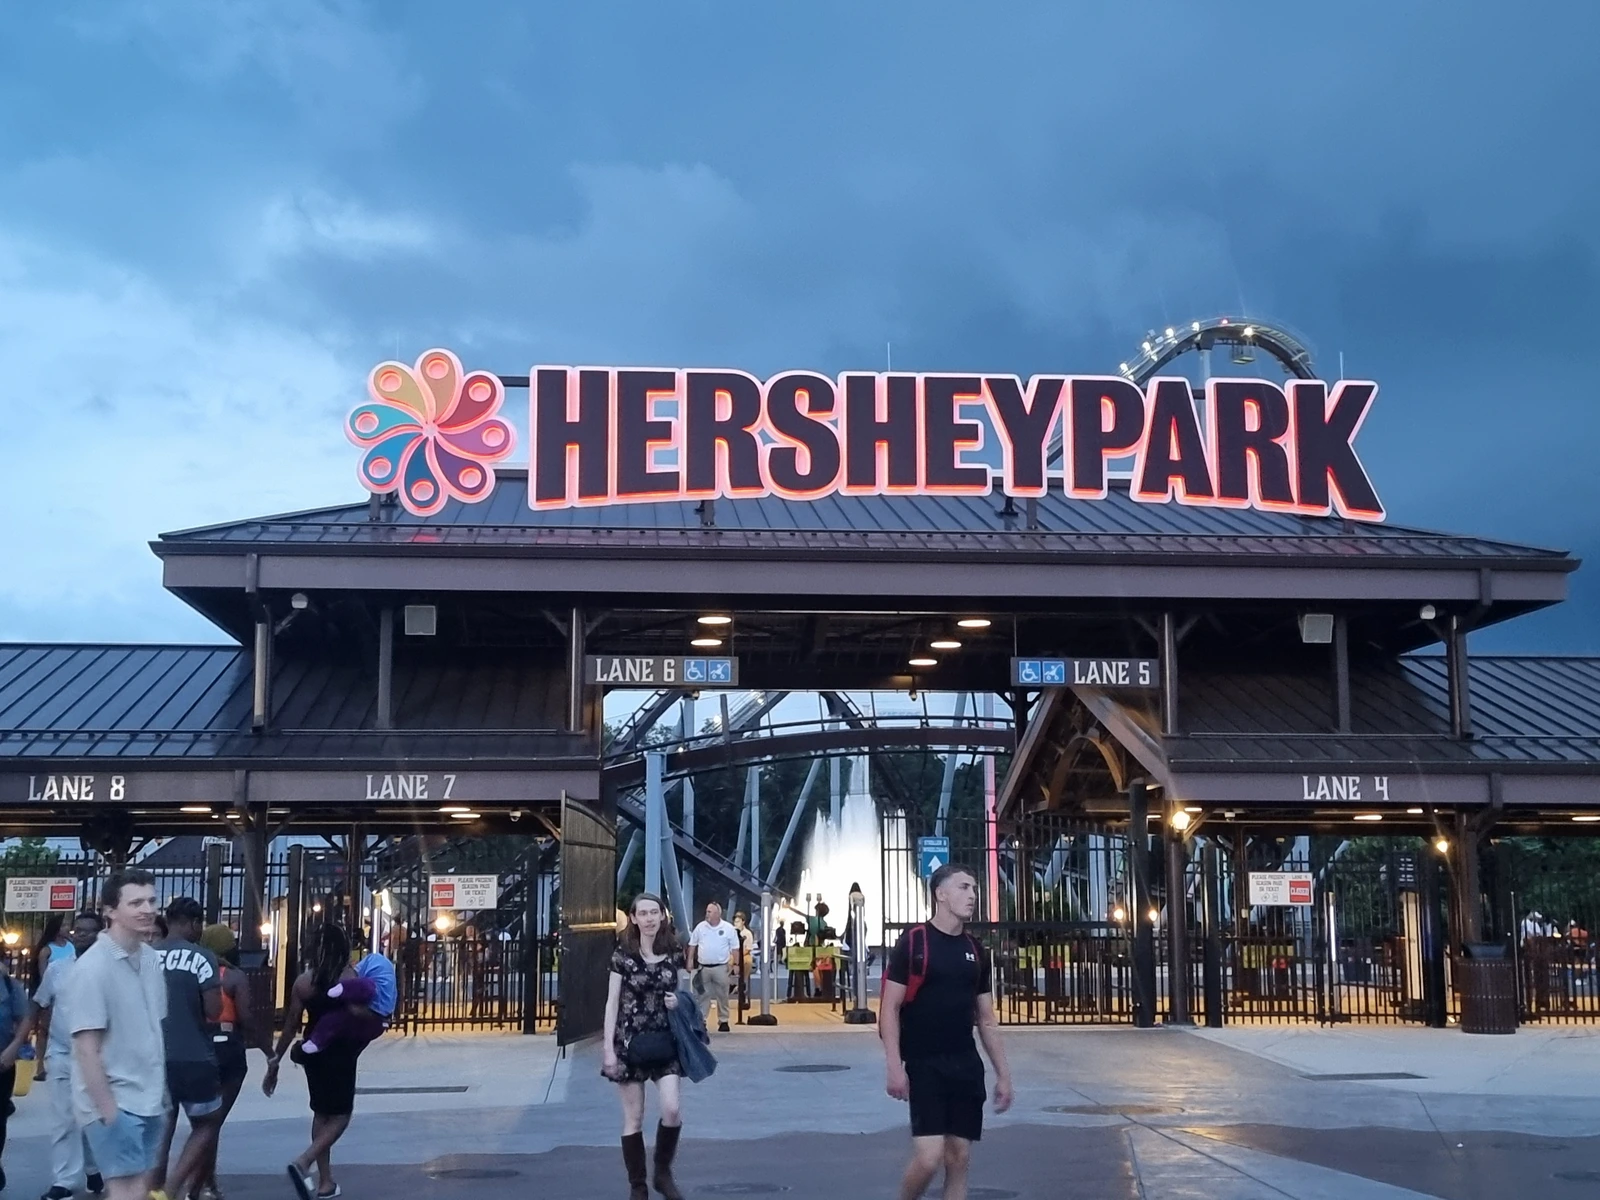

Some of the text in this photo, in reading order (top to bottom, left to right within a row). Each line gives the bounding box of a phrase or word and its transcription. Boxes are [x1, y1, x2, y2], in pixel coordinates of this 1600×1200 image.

[529, 365, 1386, 522] HERSHEYPARK
[595, 658, 675, 682] LANE 6
[1073, 661, 1150, 685] LANE 5
[28, 775, 125, 801] LANE 8
[366, 774, 457, 800] LANE 7
[1302, 775, 1390, 801] LANE 4
